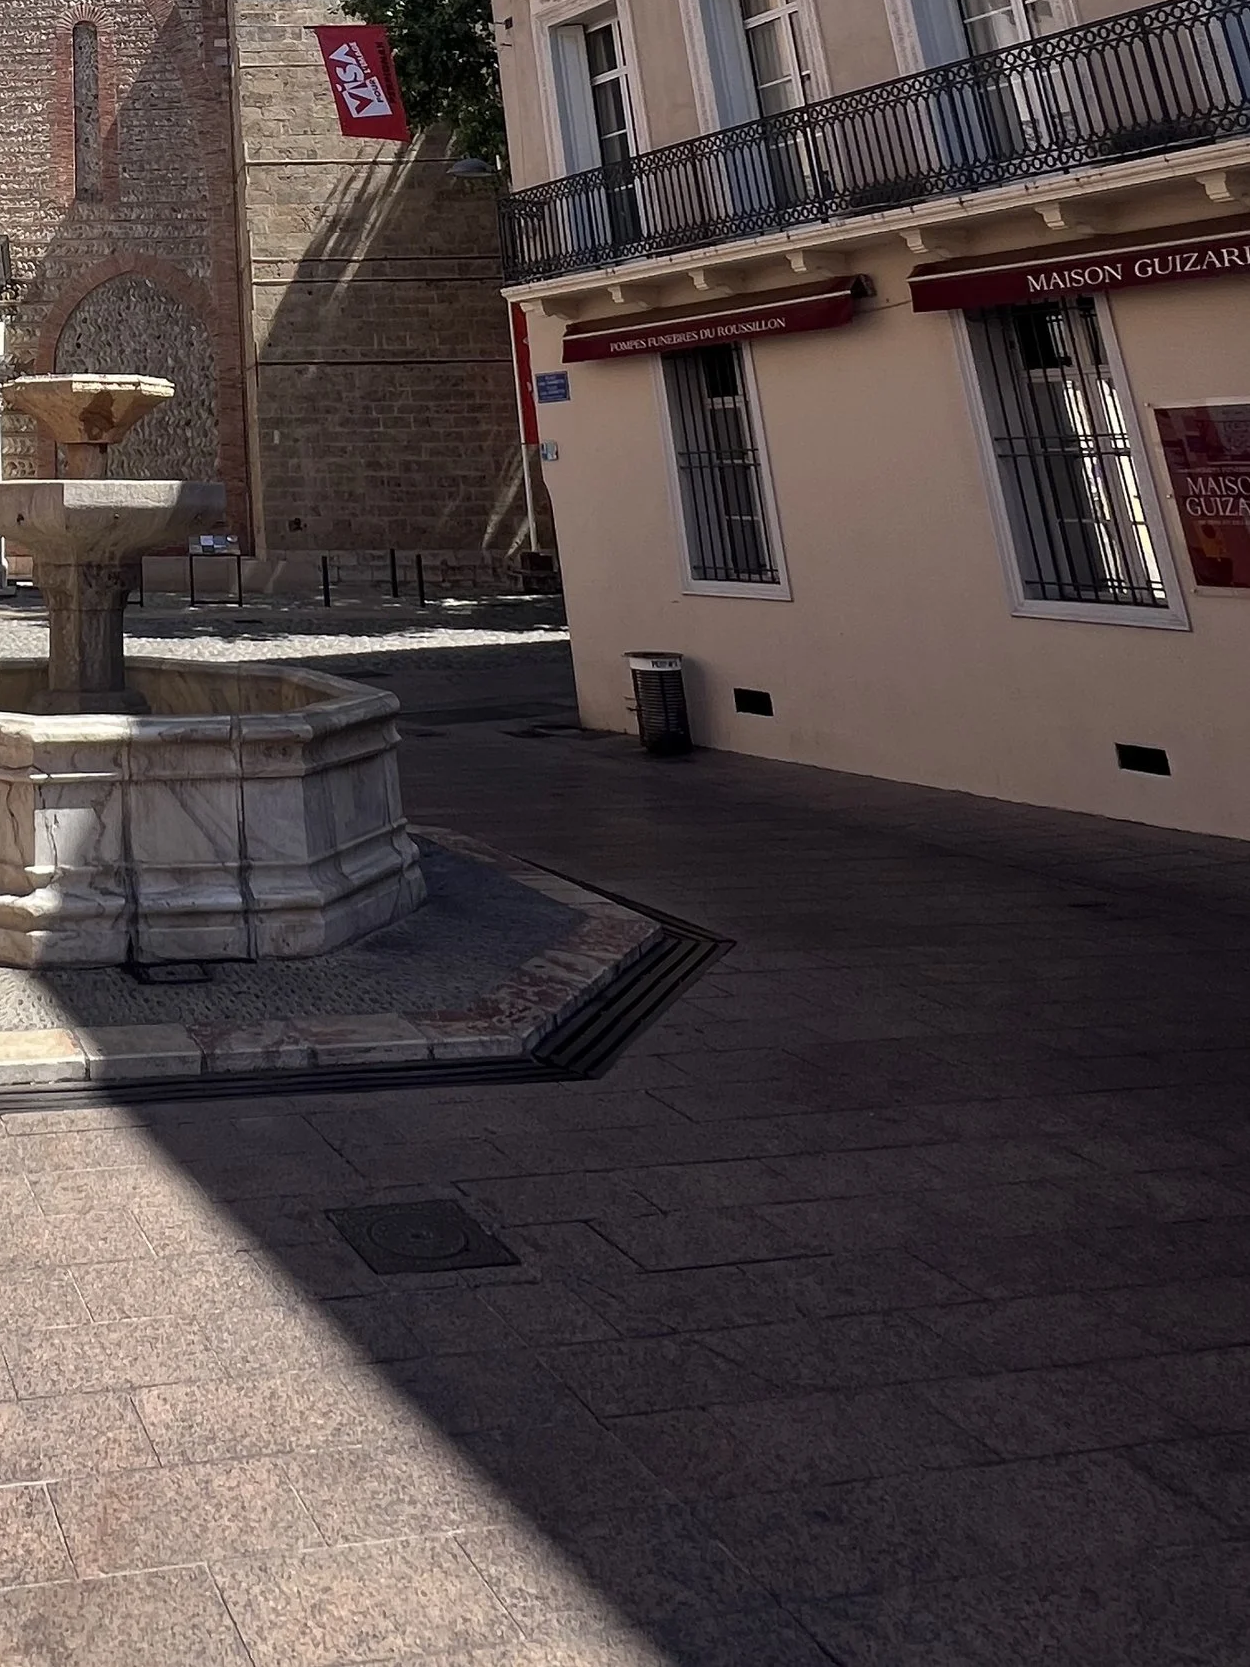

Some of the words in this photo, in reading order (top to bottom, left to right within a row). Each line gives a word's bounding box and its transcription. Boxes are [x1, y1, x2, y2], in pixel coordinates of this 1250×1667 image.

[1026, 263, 1123, 293] MAISON
[609, 340, 647, 353] POMPES
[699, 327, 716, 340] DU
[718, 317, 786, 337] ROUSSILLON
